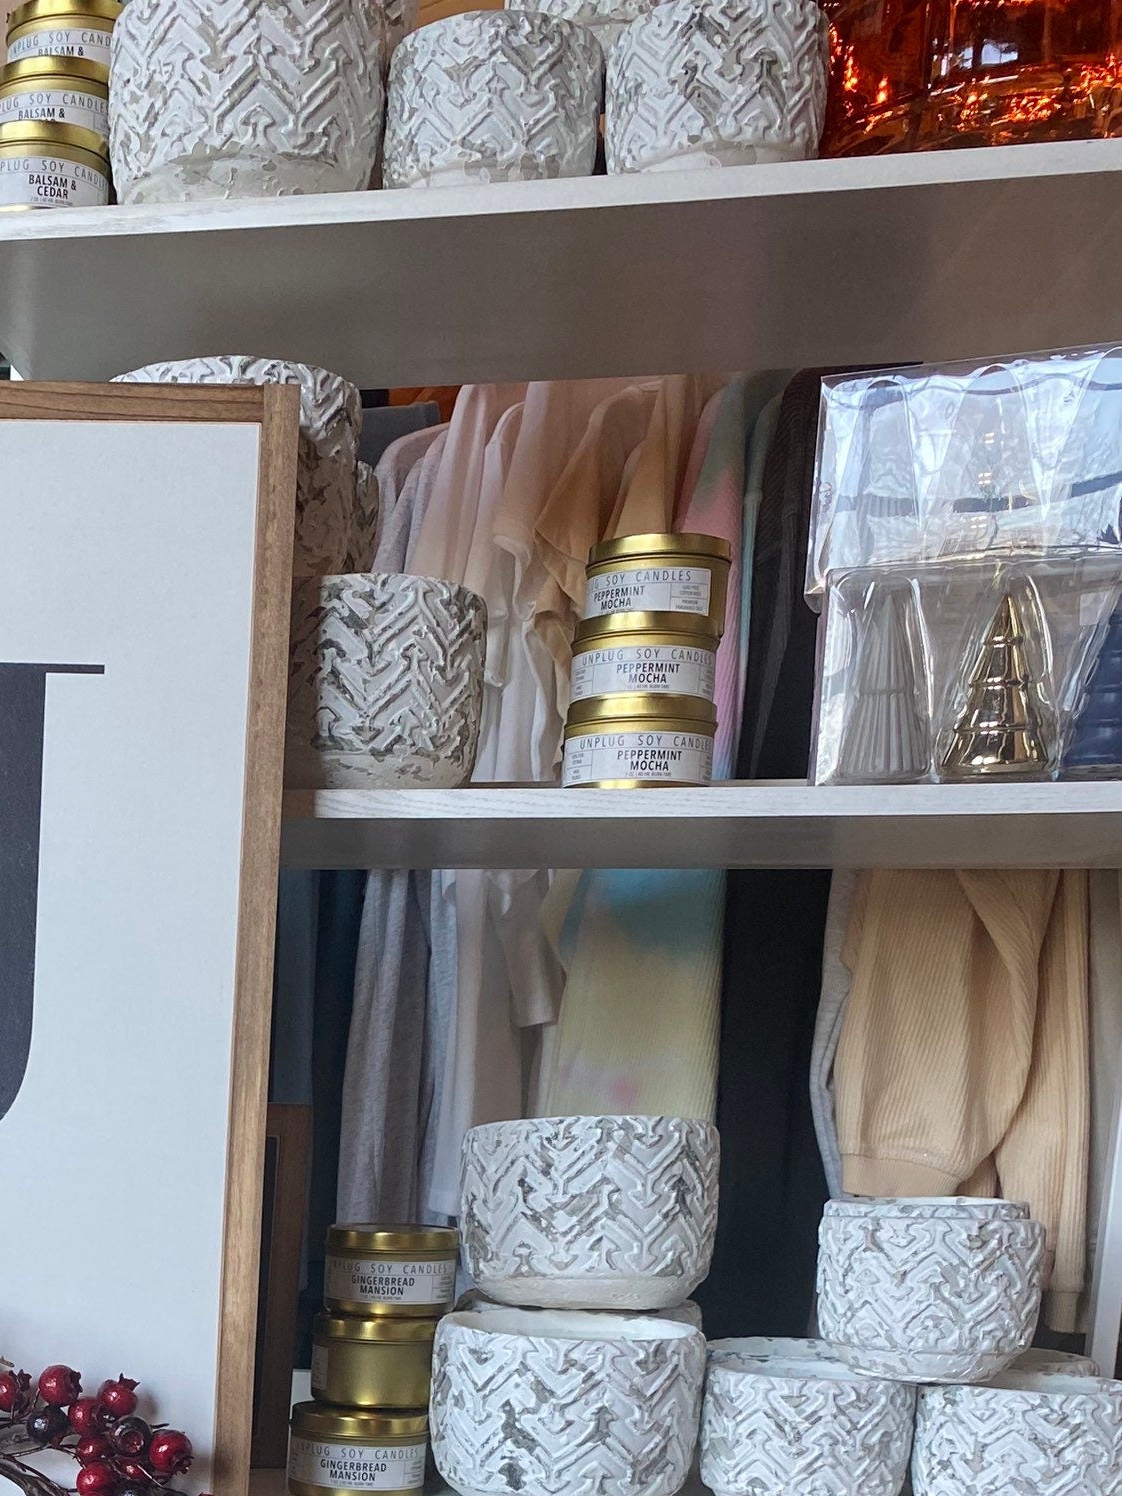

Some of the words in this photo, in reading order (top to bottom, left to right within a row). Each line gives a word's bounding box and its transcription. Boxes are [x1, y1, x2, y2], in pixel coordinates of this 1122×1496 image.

[48, 29, 71, 42] SOY
[81, 32, 112, 48] CAND
[29, 93, 52, 105] SOY
[18, 107, 55, 120] BALSAM
[58, 108, 65, 118] &
[41, 160, 65, 172] SOY
[28, 174, 68, 188] BALSAM
[70, 180, 77, 191] &
[37, 186, 69, 199] CEDAR
[605, 573, 626, 587] SOY
[636, 570, 692, 582] CANDLES
[594, 585, 646, 602] PEPPERMINT
[600, 597, 632, 611] MOCHA
[582, 649, 624, 666] UNPLUG
[636, 648, 661, 660] SOY
[671, 649, 714, 666] CANDLES
[616, 663, 681, 674] PEPPERMINT
[628, 672, 667, 684] MOCHA
[580, 735, 625, 750] UNPLUG
[638, 734, 663, 746] SOY
[617, 749, 682, 761] PEPPERMINT
[630, 760, 669, 771] MOCHA
[371, 1263, 393, 1274] SOY
[402, 1264, 447, 1274] CANDLES
[351, 1274, 415, 1287] GINGERBREAD
[359, 1284, 404, 1296] MANSION
[341, 1447, 364, 1459] SOY
[374, 1449, 419, 1460] CANDLES
[320, 1458, 387, 1473] GINGERBREAD
[329, 1470, 376, 1482] MANSION
